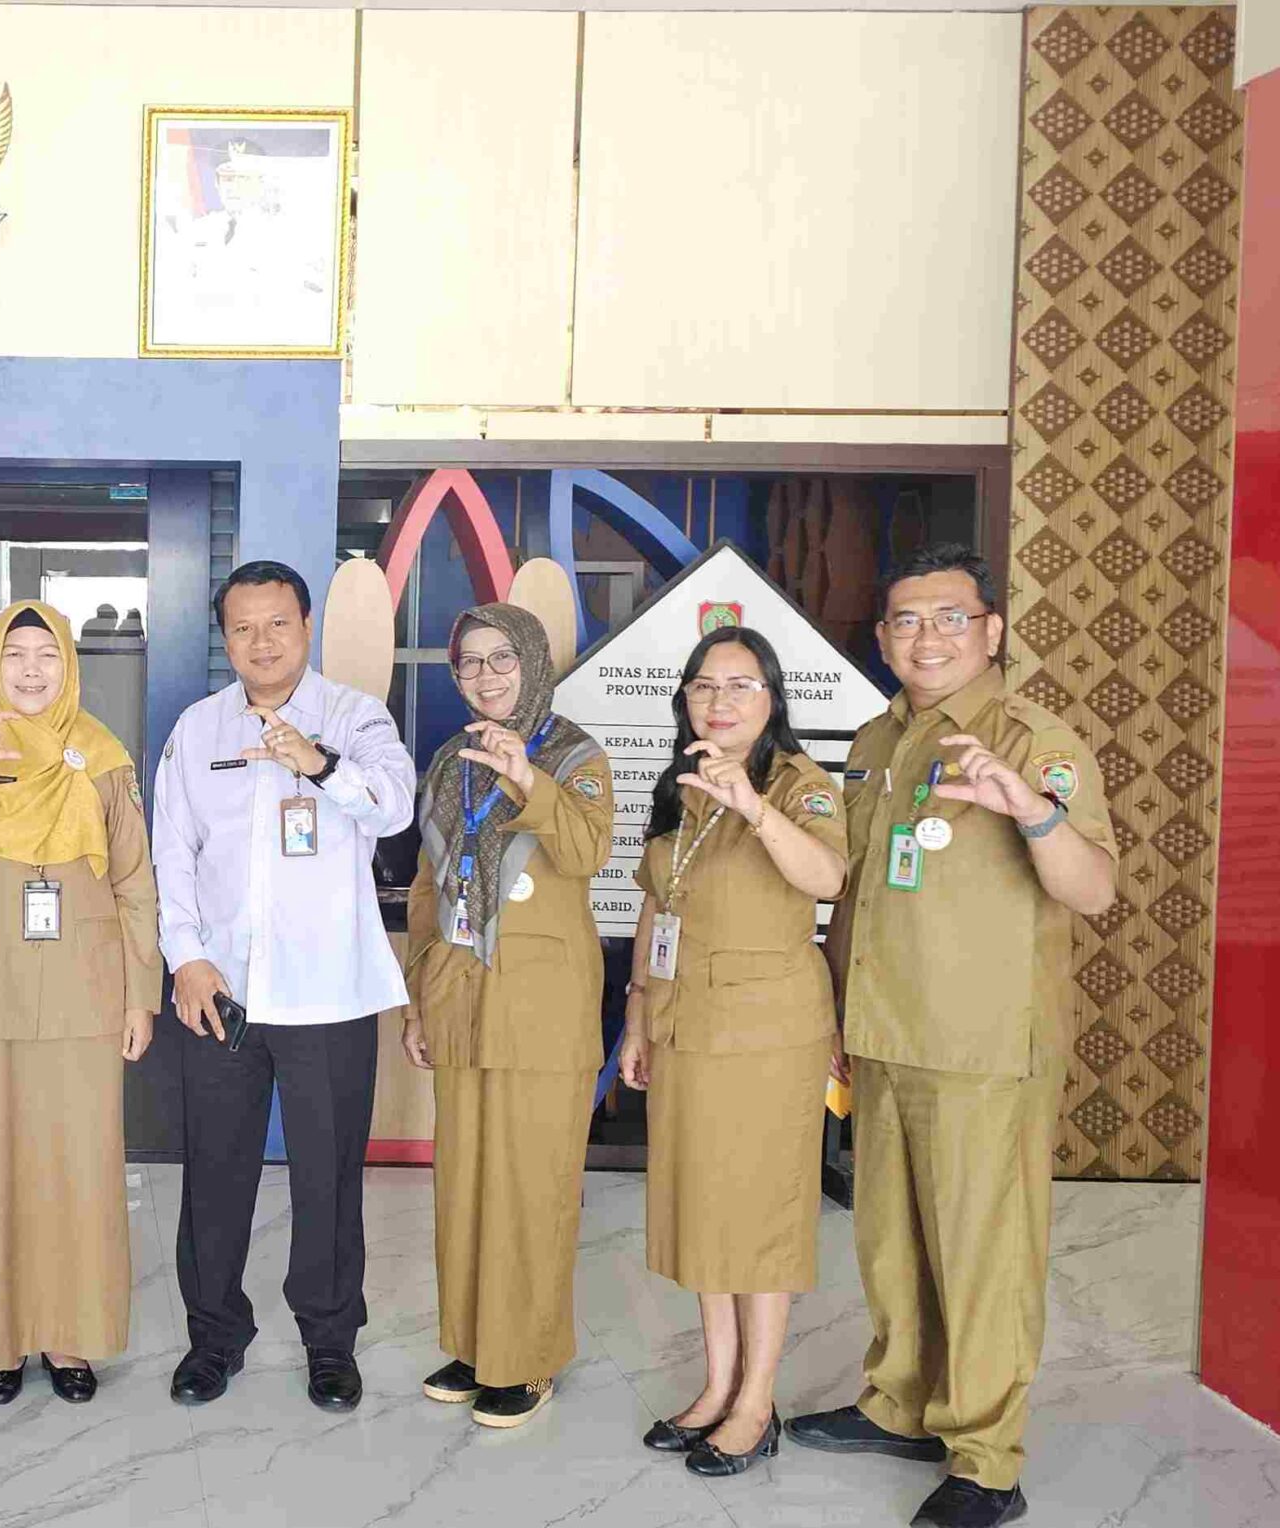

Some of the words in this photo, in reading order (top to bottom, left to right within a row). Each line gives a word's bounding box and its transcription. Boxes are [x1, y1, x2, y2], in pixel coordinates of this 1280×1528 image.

[598, 666, 642, 678] DINAS
[646, 667, 684, 679] KELA
[780, 671, 842, 683] RIKANAN
[606, 684, 674, 696] PROVINSI
[783, 688, 834, 700] ENGAH
[604, 737, 654, 748] KEPALA
[614, 803, 653, 814] LAUTA
[592, 868, 627, 879] ABID.
[592, 901, 636, 912] KABID.
